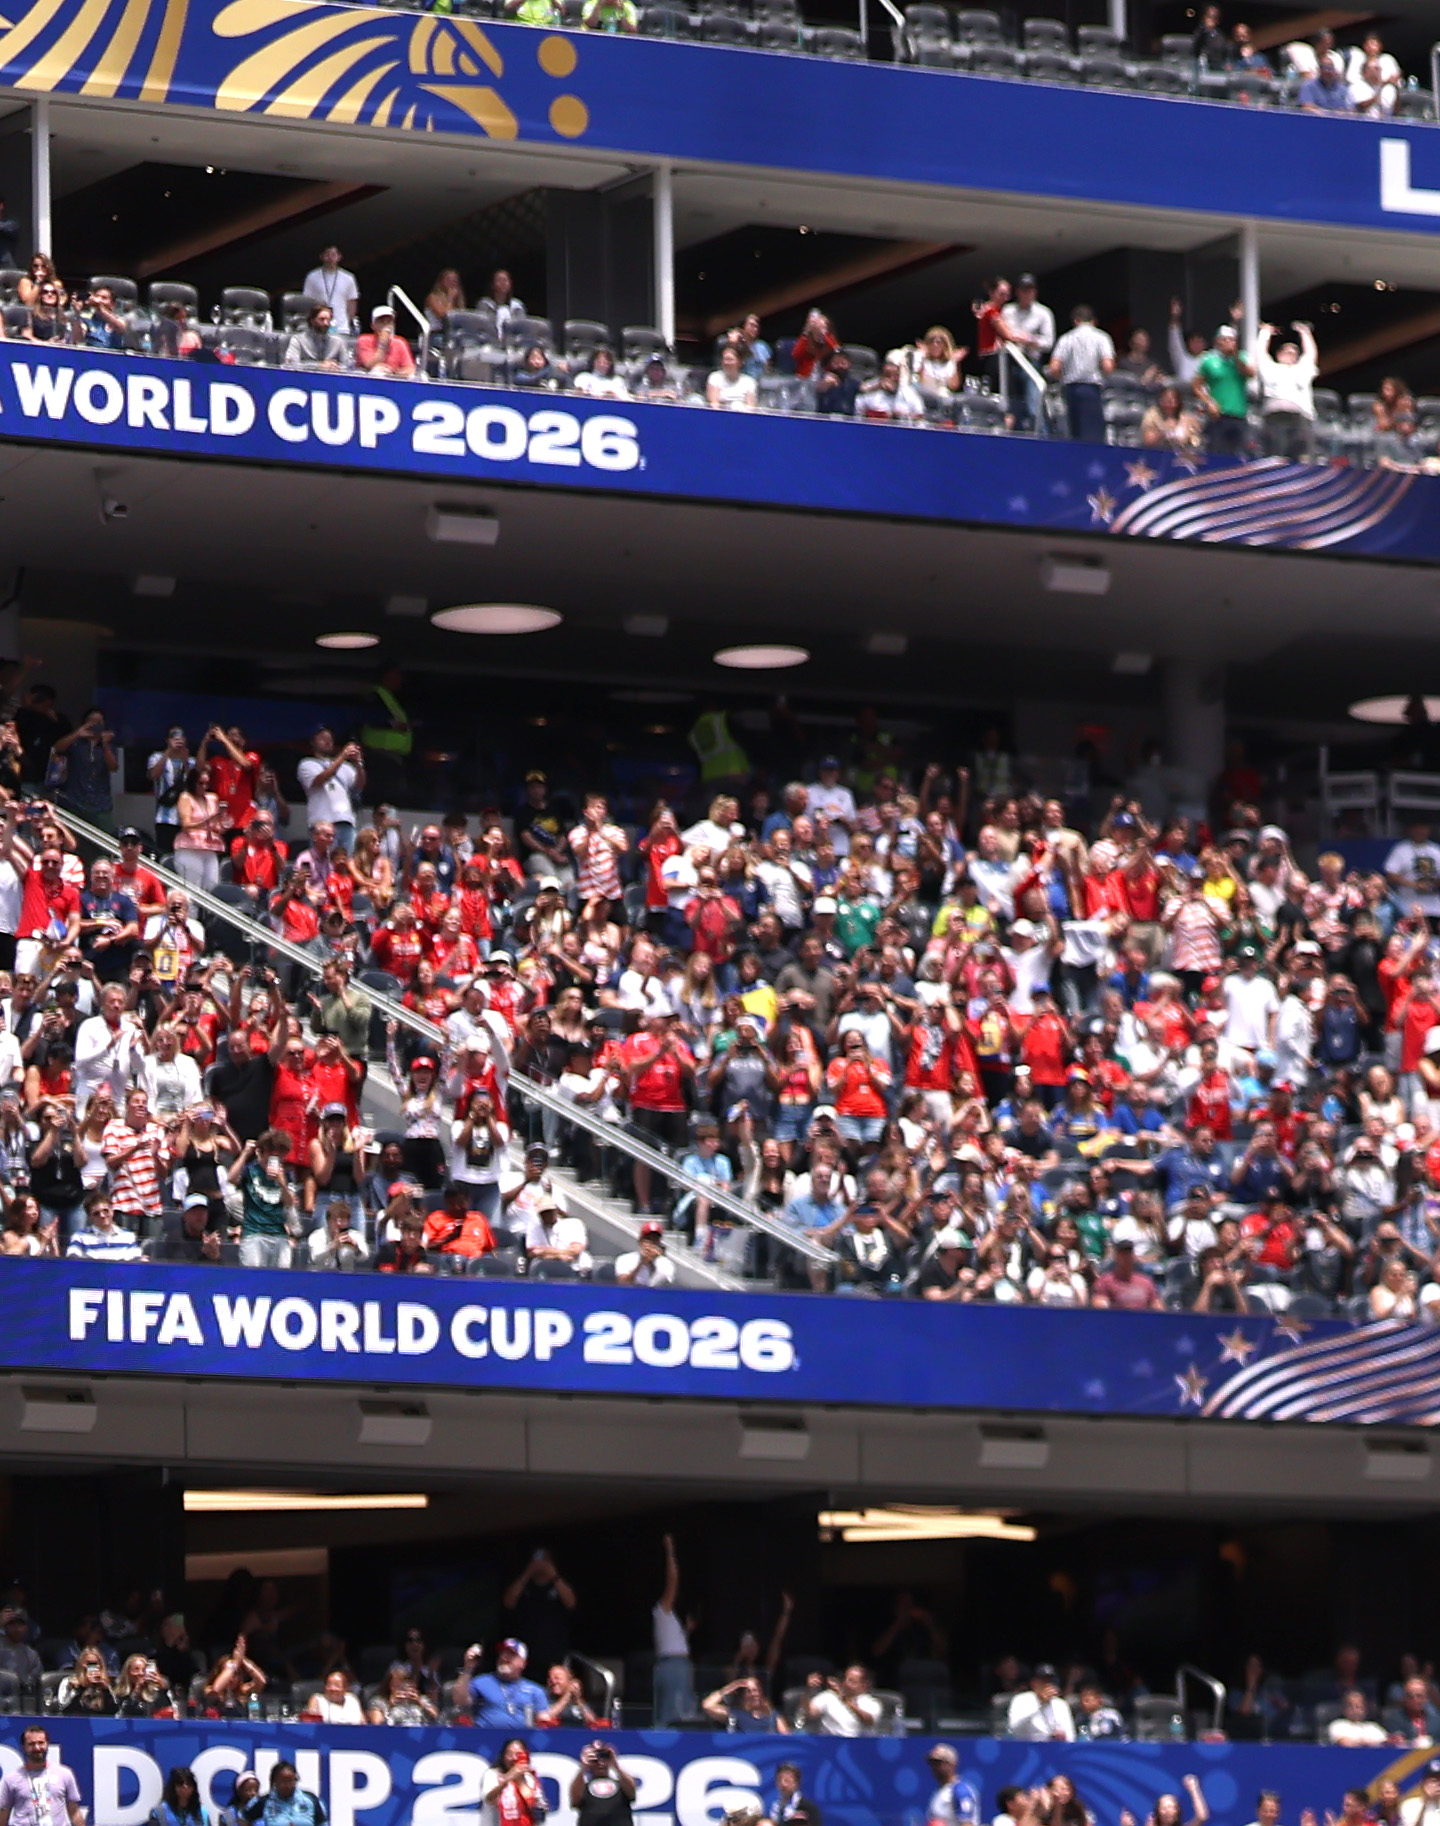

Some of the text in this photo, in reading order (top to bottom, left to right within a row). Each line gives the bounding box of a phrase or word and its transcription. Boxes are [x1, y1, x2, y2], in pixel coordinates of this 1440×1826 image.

[11, 362, 640, 470] WORLD CUP 2026
[70, 1288, 792, 1373] FIFA WORLD CUP 2026
